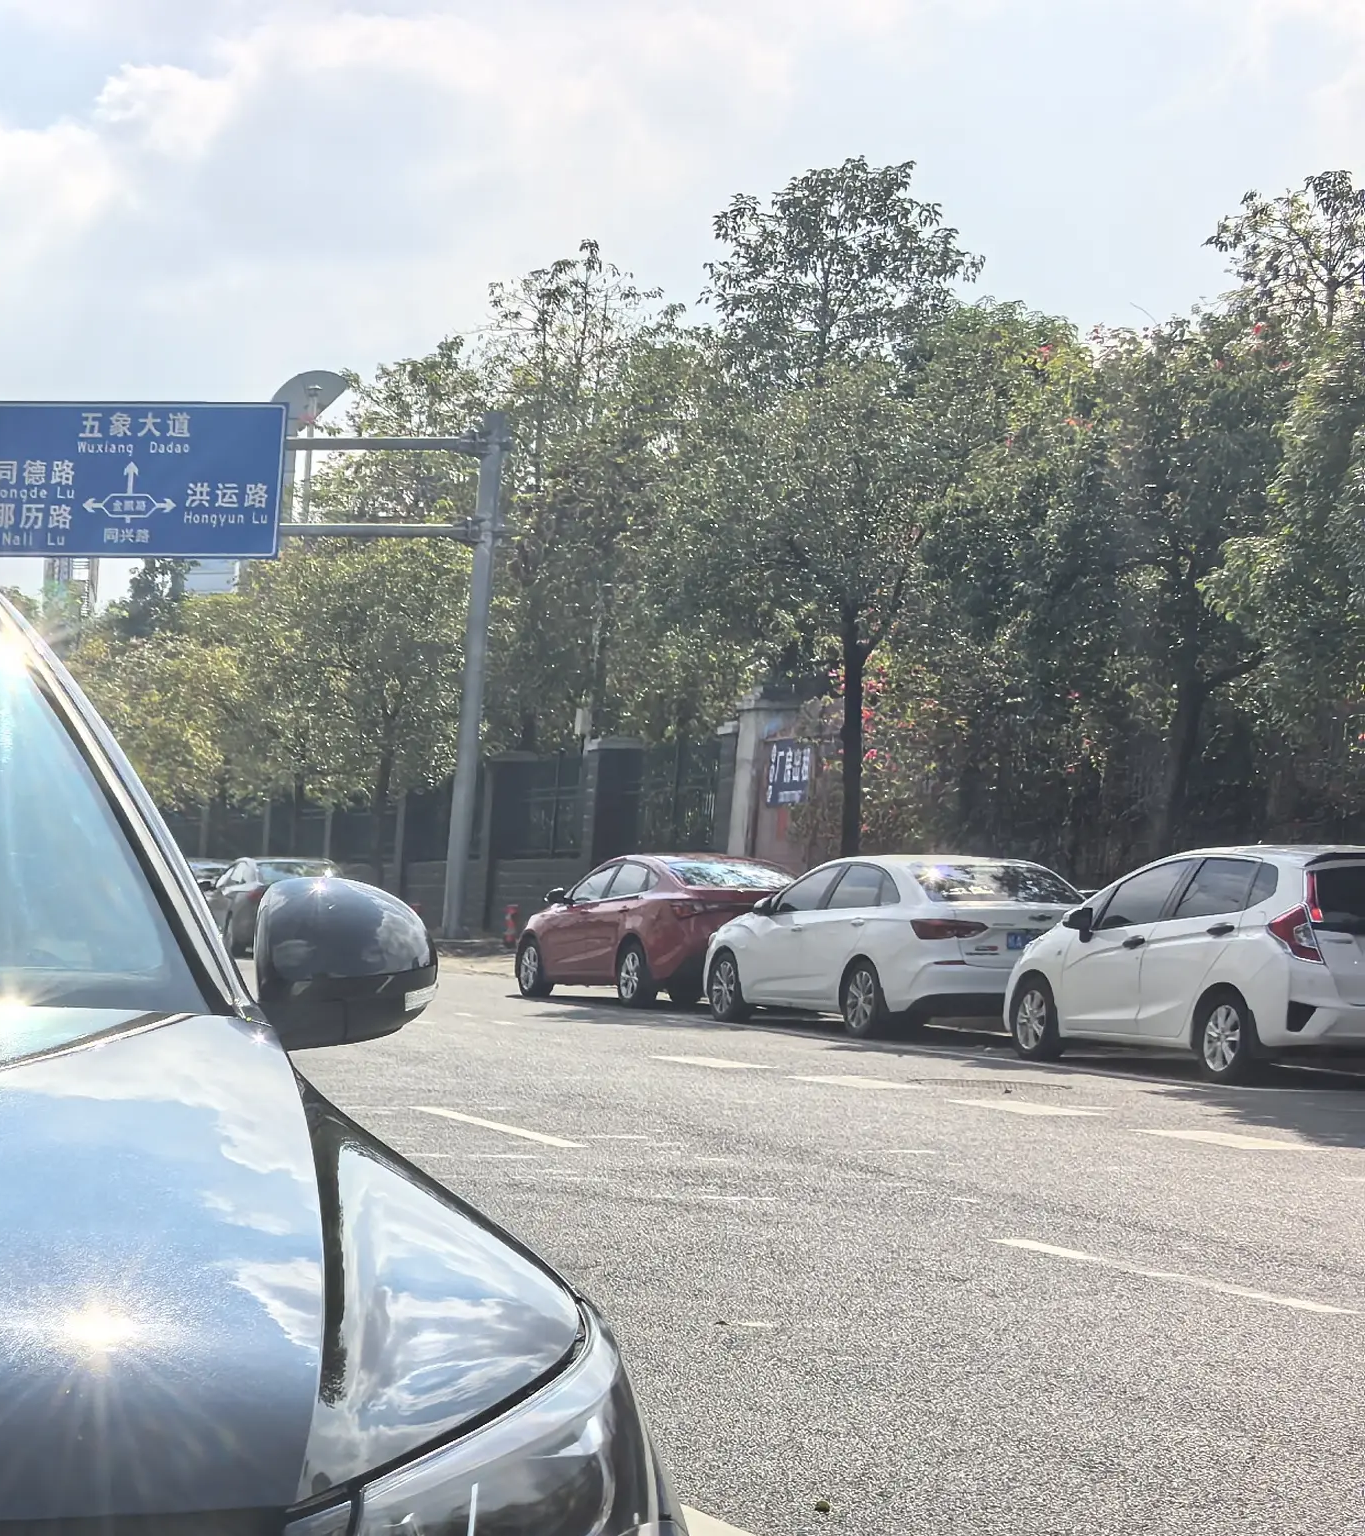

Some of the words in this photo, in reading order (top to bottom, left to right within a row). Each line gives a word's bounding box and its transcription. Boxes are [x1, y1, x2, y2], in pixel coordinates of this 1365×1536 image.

[78, 412, 191, 437] 五象大道
[77, 441, 134, 456] Wuxiang
[149, 441, 190, 453] Dadao
[57, 487, 75, 498] Lu
[185, 482, 268, 508] 洪运路
[184, 511, 245, 528] Hongyun
[252, 511, 268, 524] Lu
[47, 532, 65, 546] Lu
[103, 528, 150, 543] 同兴路
